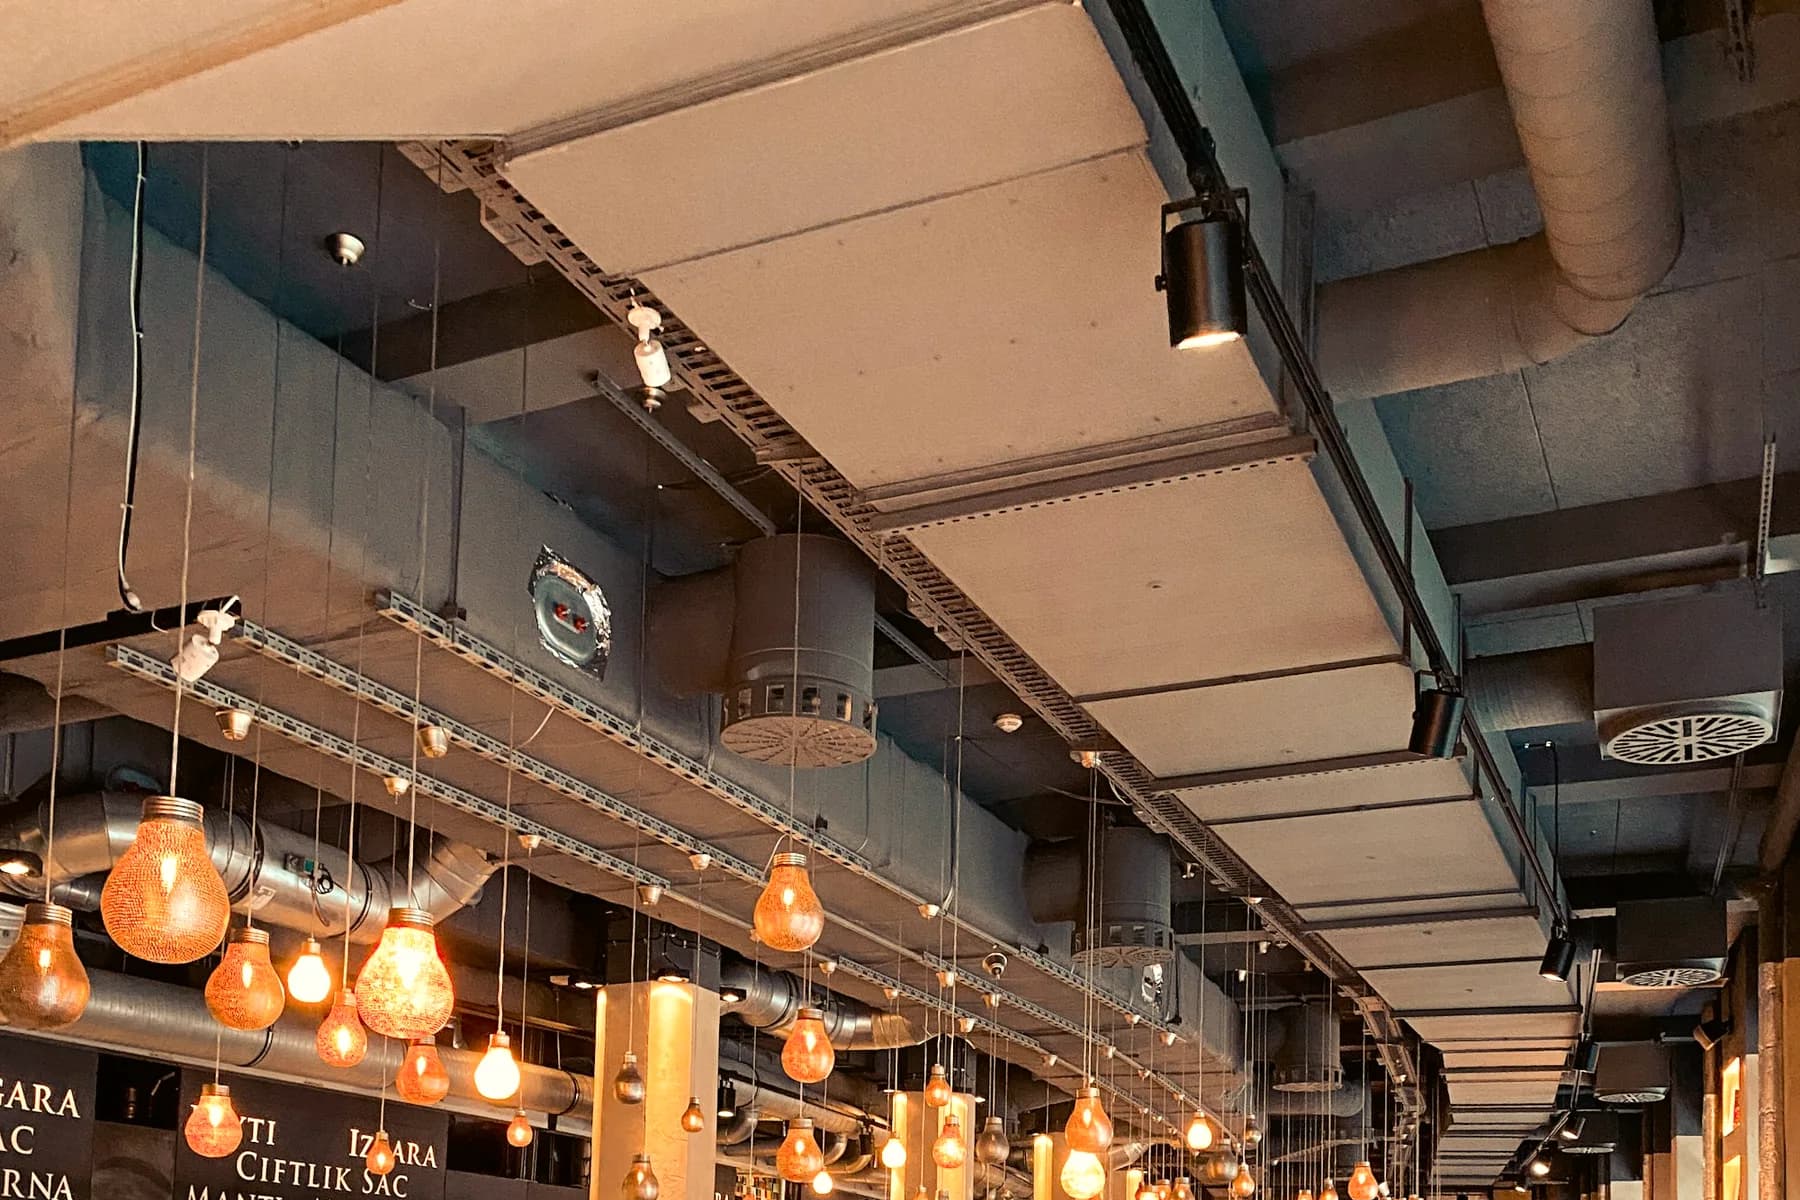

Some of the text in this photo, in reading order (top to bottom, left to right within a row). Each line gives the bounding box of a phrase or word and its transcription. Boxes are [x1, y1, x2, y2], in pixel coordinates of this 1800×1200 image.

[0, 1078, 80, 1118] ARA
[349, 1128, 438, 1168] IZARA
[236, 1150, 409, 1198] CIFTLIK SAC
